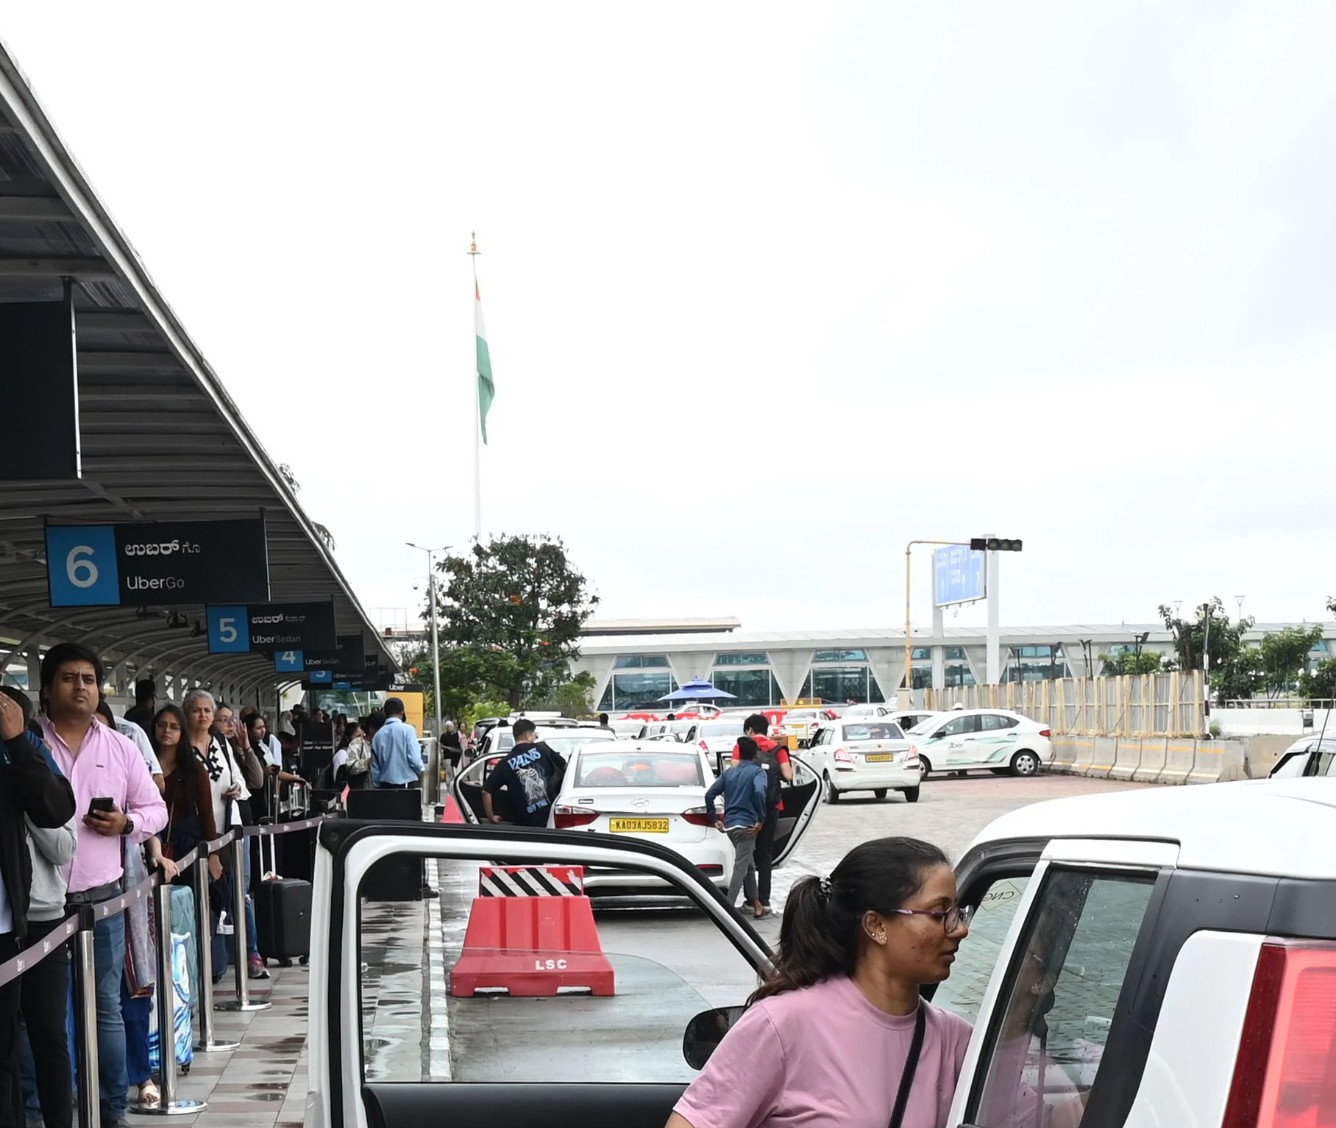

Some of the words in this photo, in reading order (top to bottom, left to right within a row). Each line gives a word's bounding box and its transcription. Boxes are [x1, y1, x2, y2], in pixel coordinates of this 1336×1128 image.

[125, 539, 180, 556] ಉಬರ್
[66, 545, 98, 588] 6
[126, 576, 185, 590] UberGo
[219, 617, 237, 643] 5
[281, 651, 296, 664] 4
[507, 747, 542, 771] VANS
[615, 820, 668, 830] KA03AJ5832
[535, 959, 567, 970] LSC
